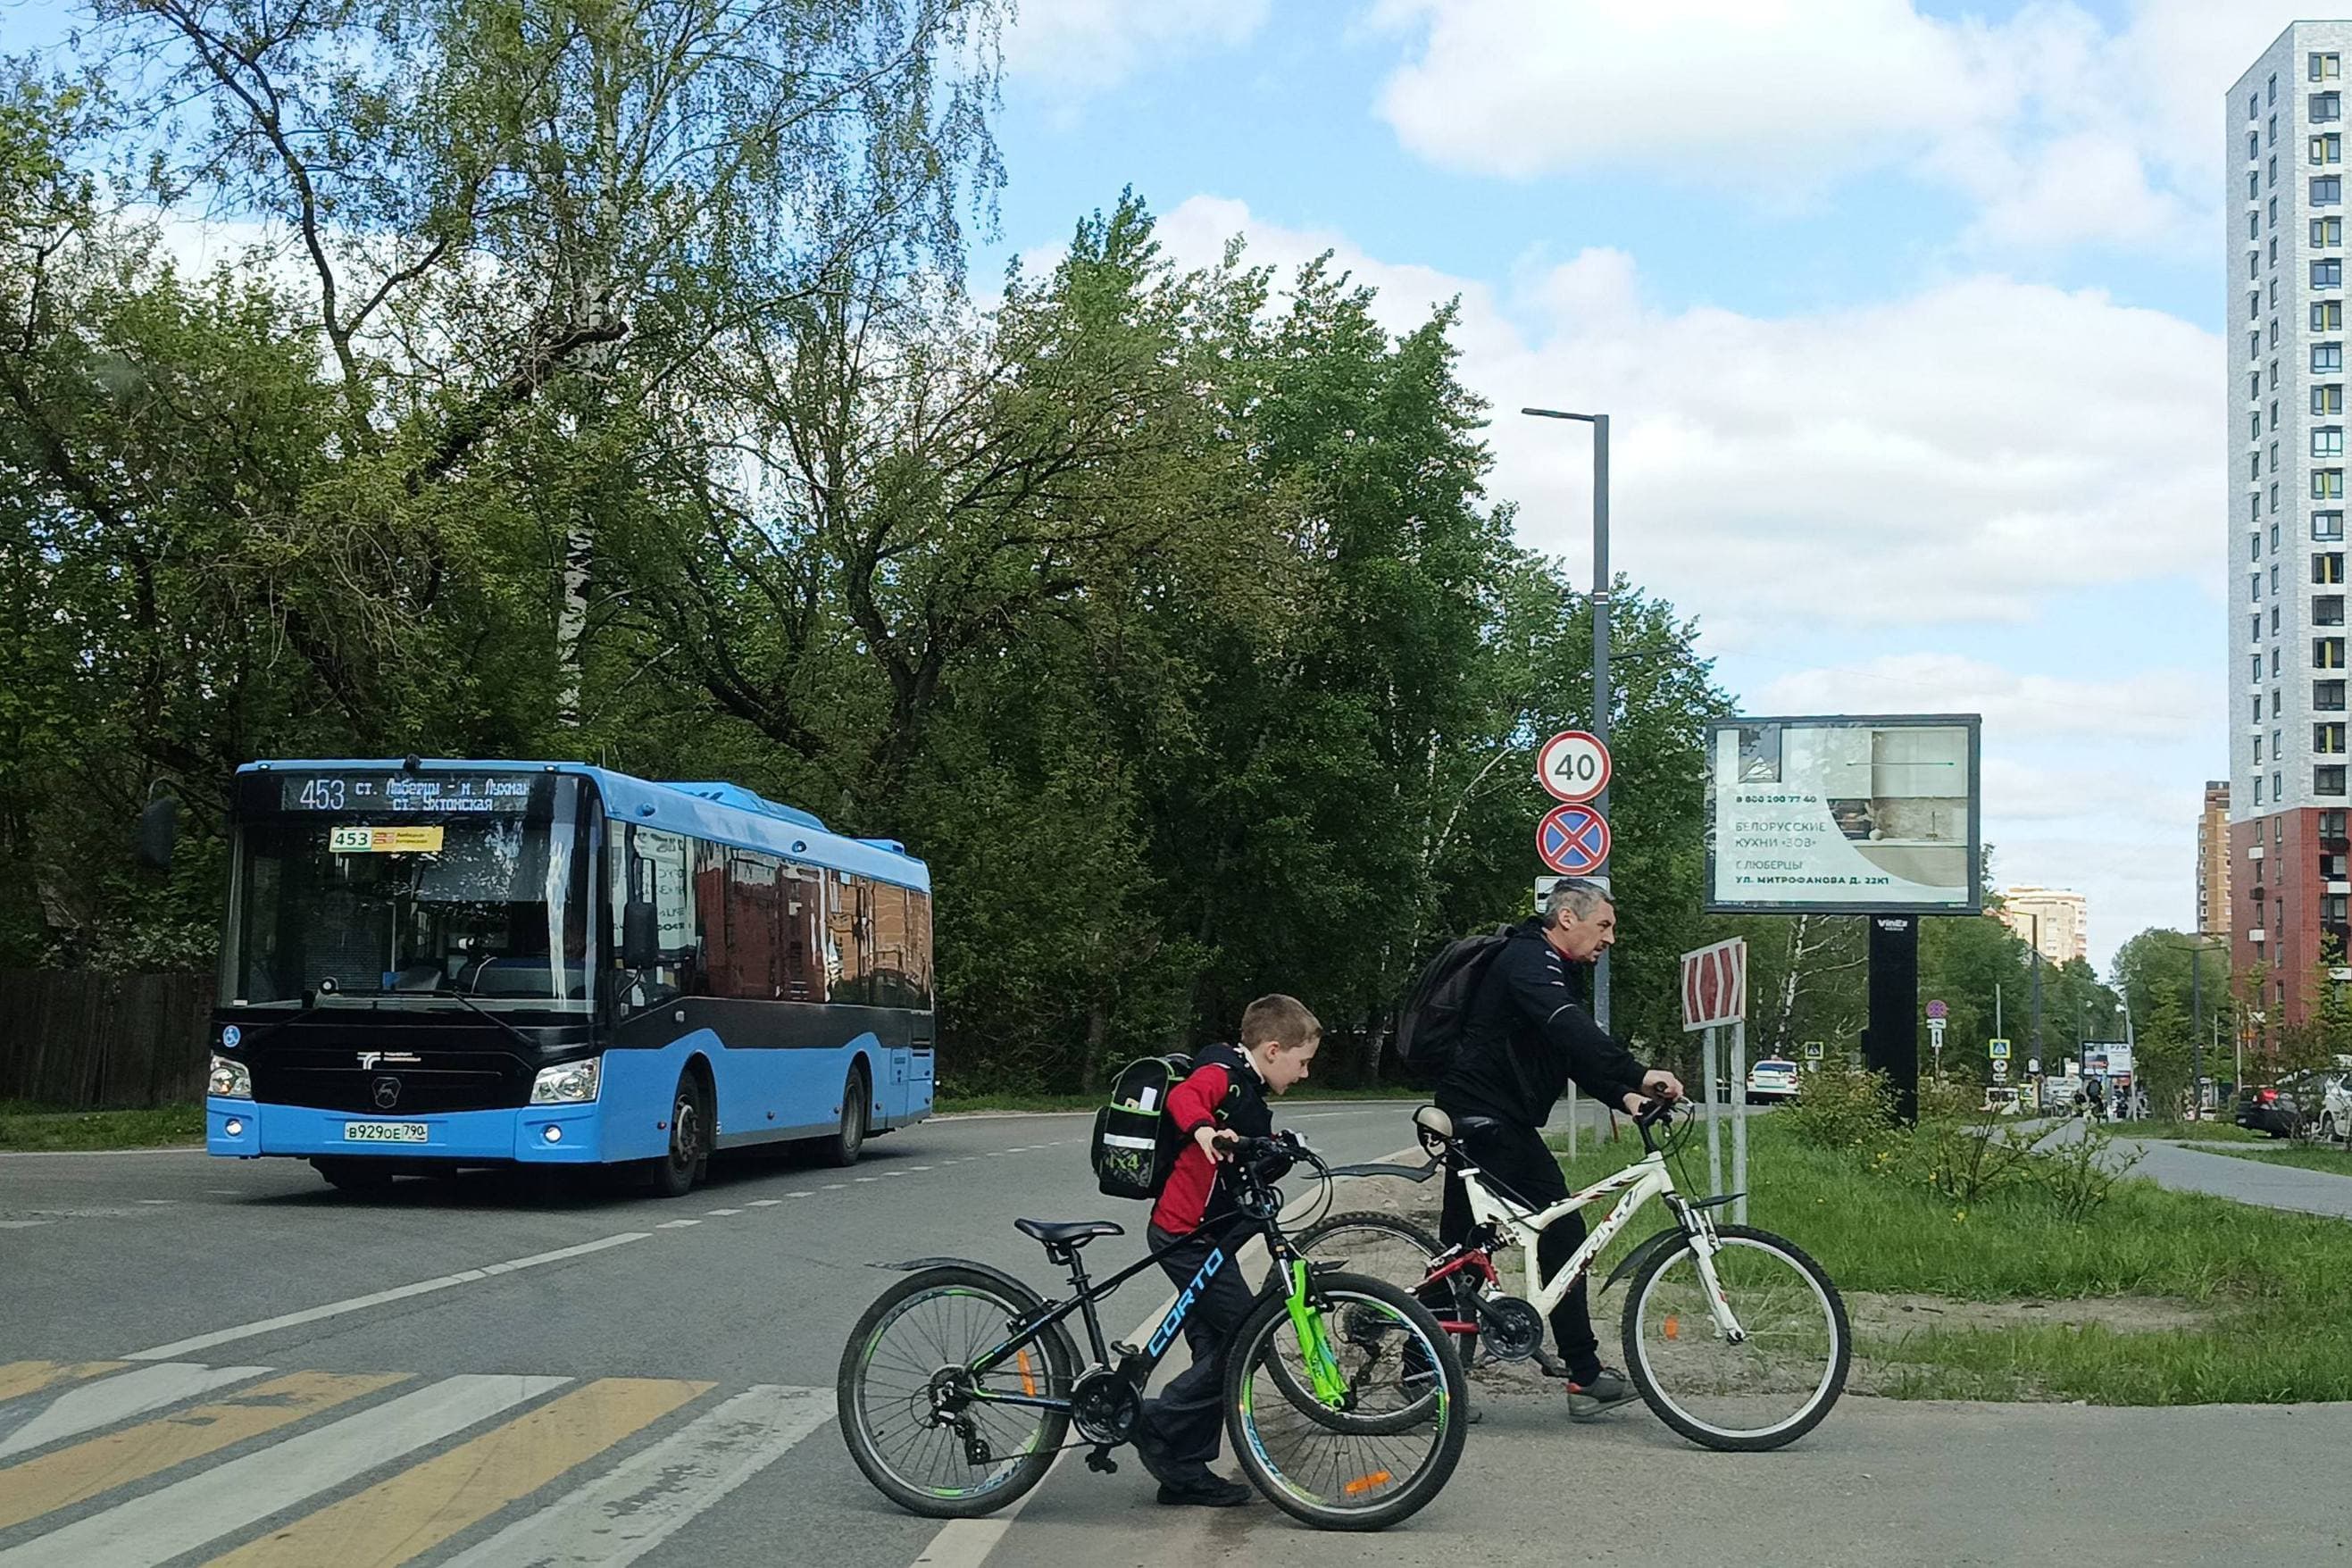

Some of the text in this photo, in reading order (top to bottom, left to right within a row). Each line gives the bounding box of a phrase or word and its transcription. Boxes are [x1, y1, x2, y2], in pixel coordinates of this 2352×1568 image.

[1555, 754, 1596, 781] 40
[299, 780, 346, 811] 453
[1735, 822, 1826, 832] БЕЛОРУССКИЕ
[335, 832, 369, 846] 453
[1735, 838, 1779, 847] КУХНИ
[1744, 860, 1804, 871] ЛЮБЕРЦЫ
[1756, 876, 1847, 884] МИТРОФАНОВА
[1148, 1247, 1224, 1357] CORTO
